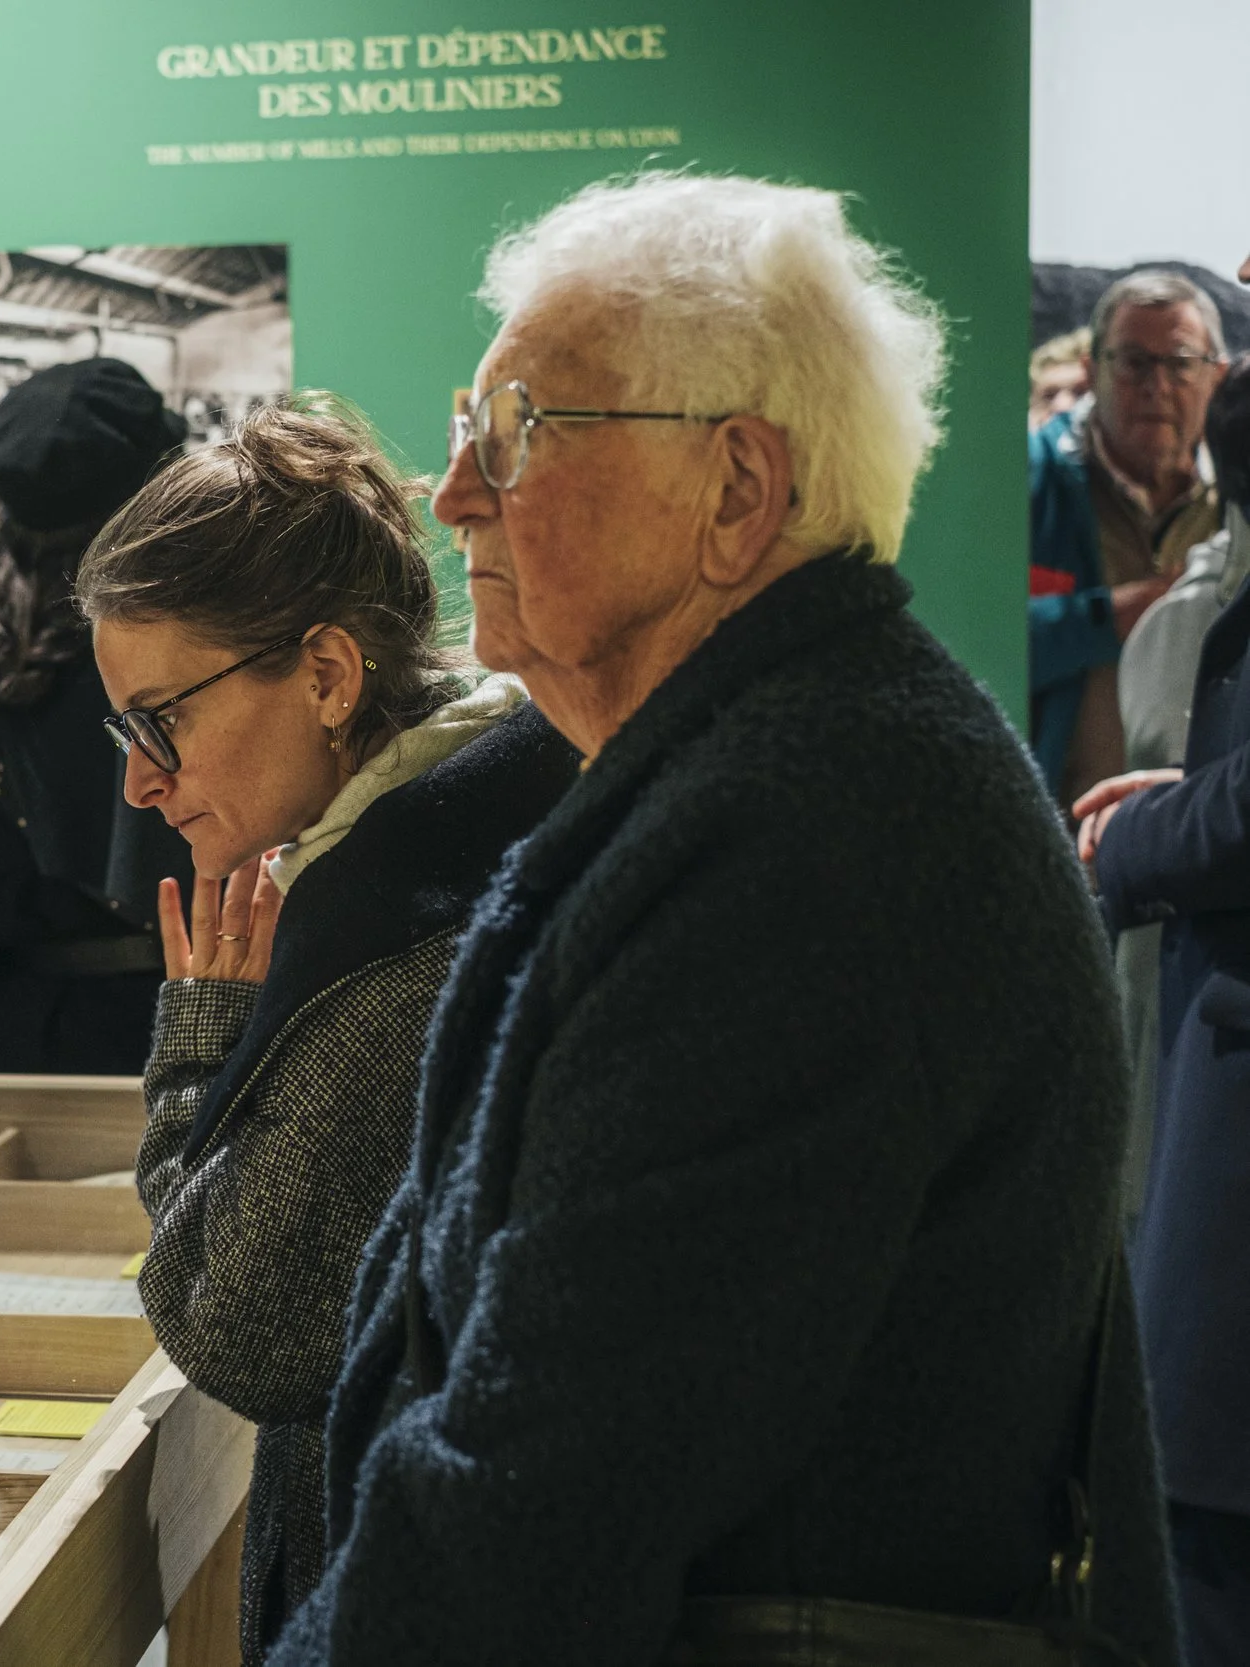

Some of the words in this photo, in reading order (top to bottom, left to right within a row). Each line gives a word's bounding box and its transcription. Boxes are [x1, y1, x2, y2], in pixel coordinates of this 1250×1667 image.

[156, 37, 356, 79] GRANDEUR
[362, 34, 411, 70] ET
[417, 25, 667, 68] DÉPENDANCE
[258, 82, 332, 118] DES
[338, 73, 562, 115] MOULINIERS
